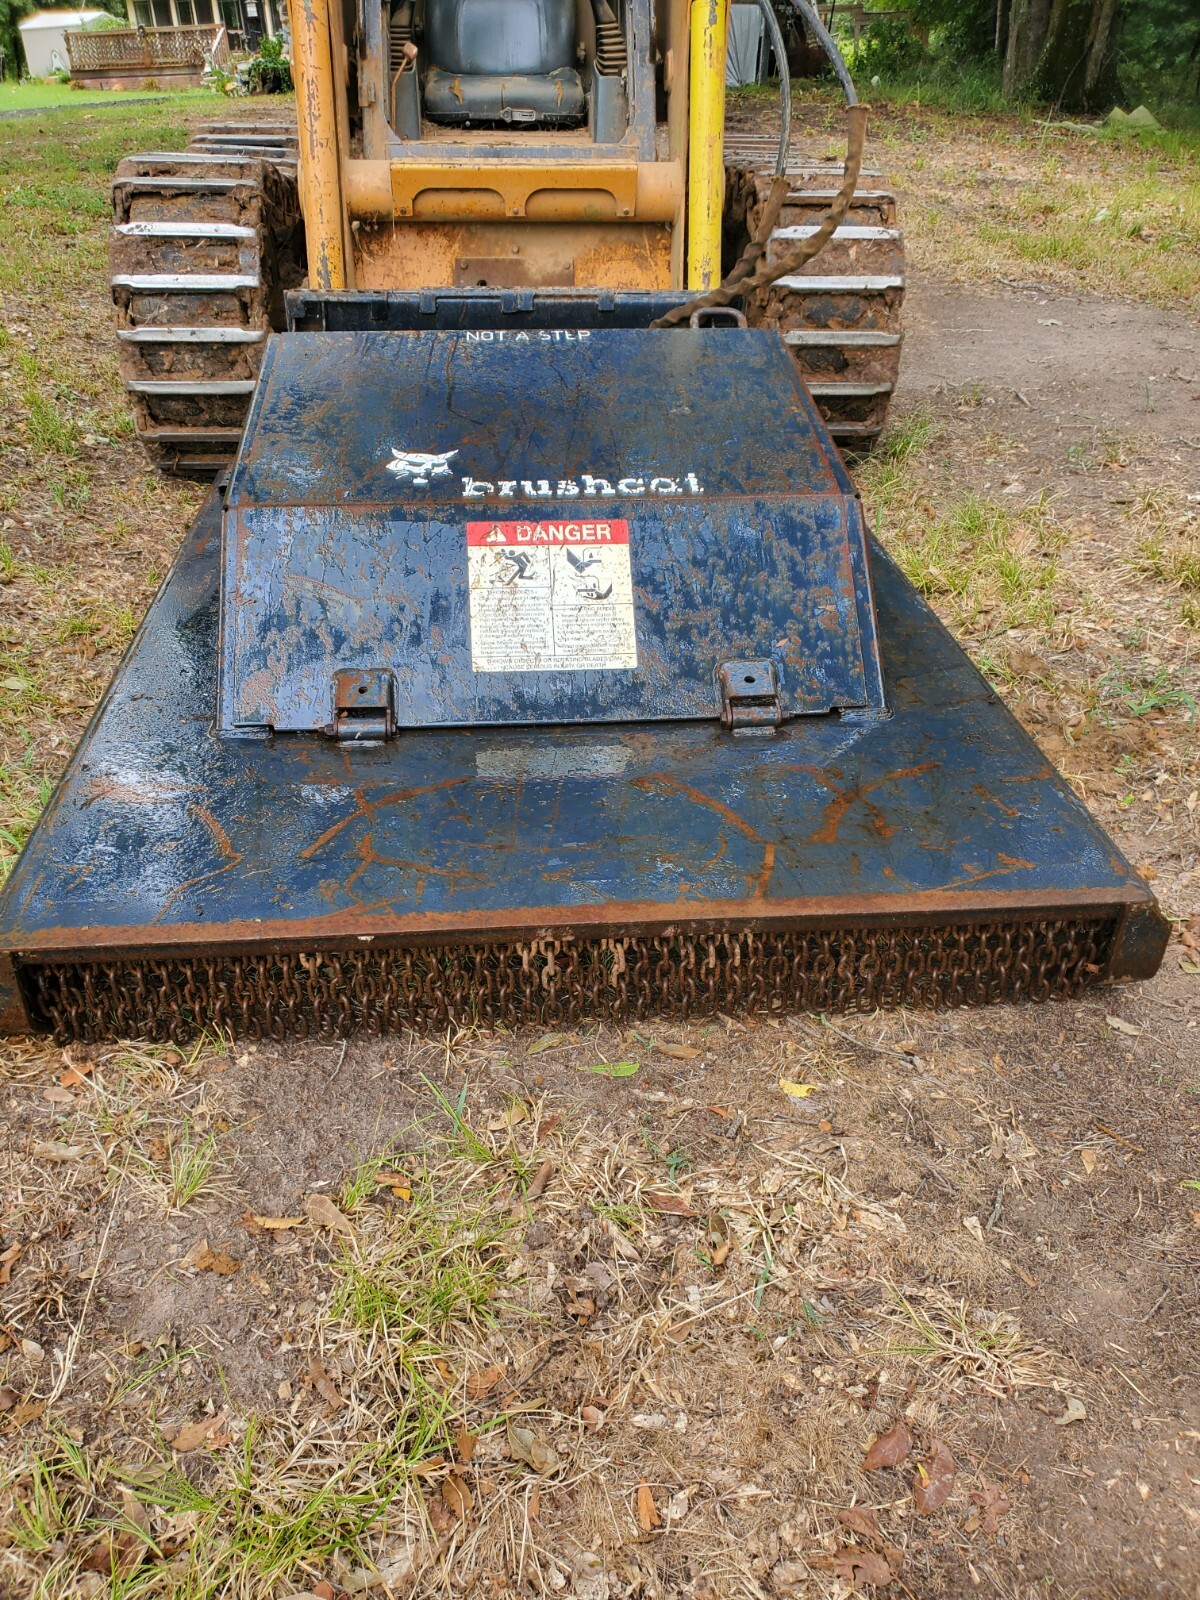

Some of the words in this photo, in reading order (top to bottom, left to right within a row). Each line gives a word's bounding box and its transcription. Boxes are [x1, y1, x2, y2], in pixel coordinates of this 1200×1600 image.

[466, 330, 507, 341] NOT
[515, 331, 530, 341] A
[539, 330, 591, 341] STEP
[461, 472, 704, 498] brushcat
[516, 523, 612, 541] DANGER
